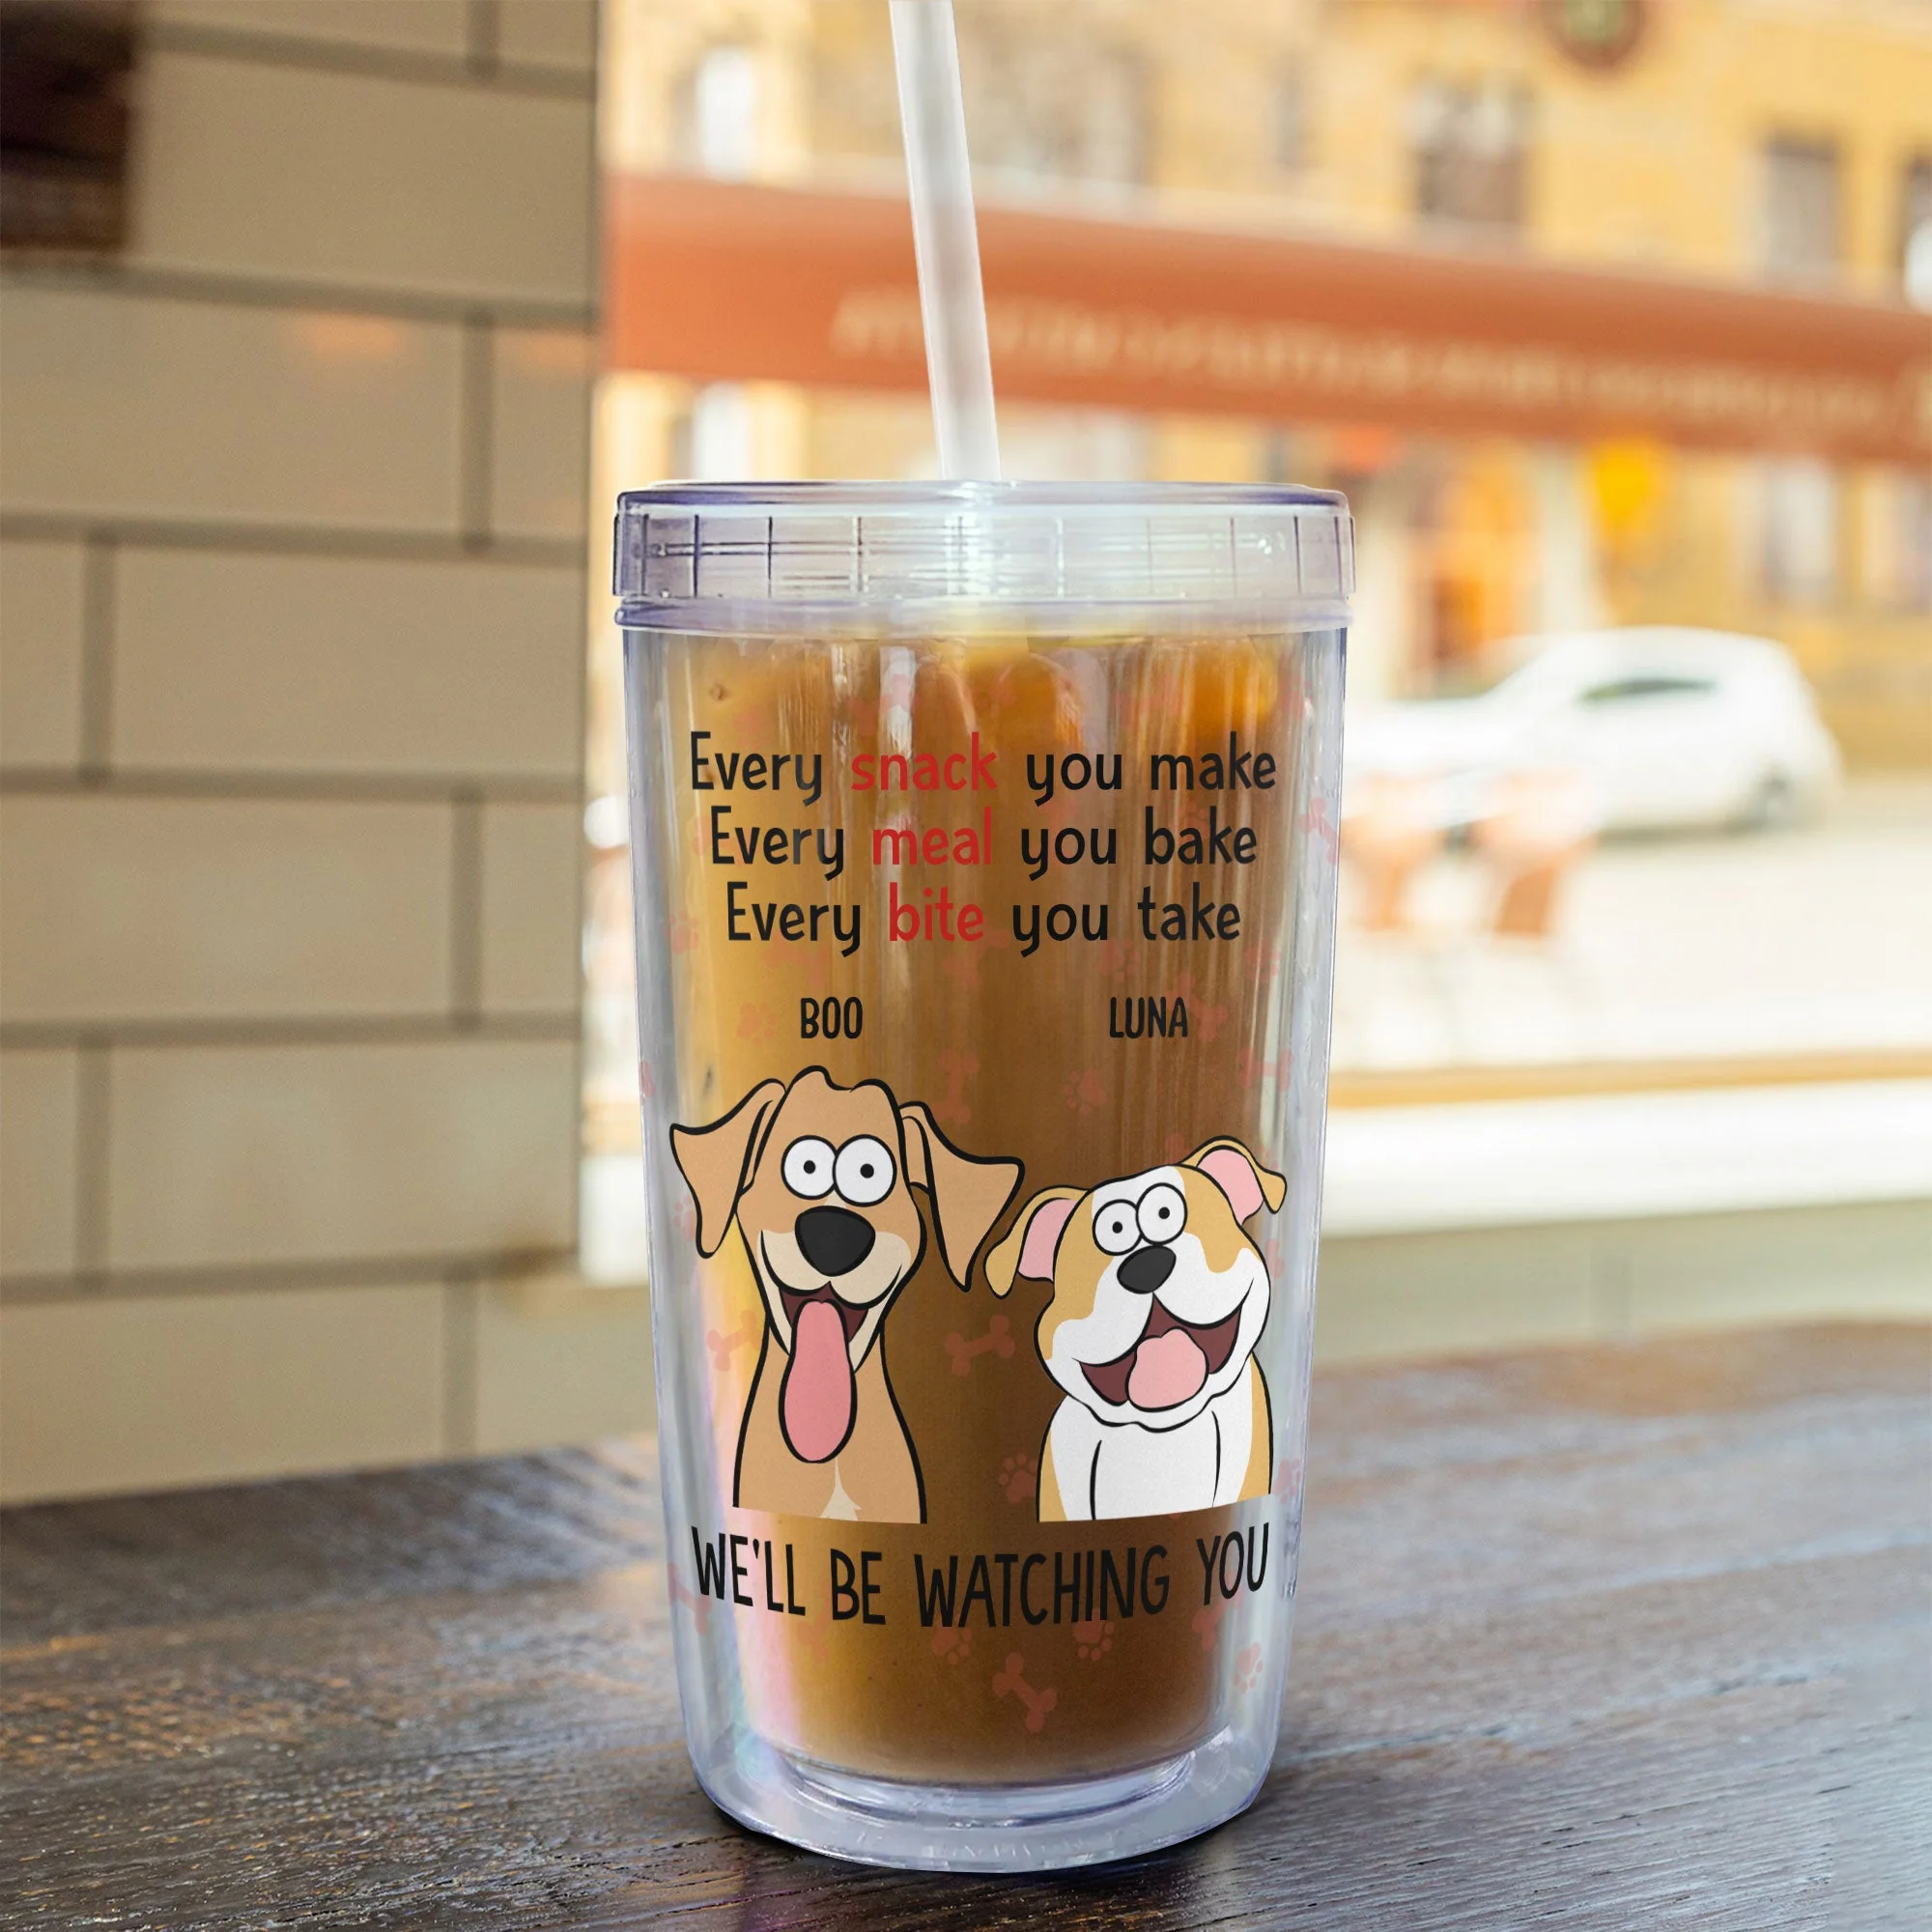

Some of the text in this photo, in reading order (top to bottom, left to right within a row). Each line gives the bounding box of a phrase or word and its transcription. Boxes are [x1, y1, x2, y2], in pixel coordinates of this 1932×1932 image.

[691, 731, 1276, 806] Every snack you make
[712, 806, 1257, 881] Every meal you bake
[727, 881, 1240, 957] Every bite you take
[801, 997, 863, 1038] BOO
[1109, 996, 1188, 1038] LUNA
[691, 1522, 1269, 1628] WE'LL BE WATCHING YOU
